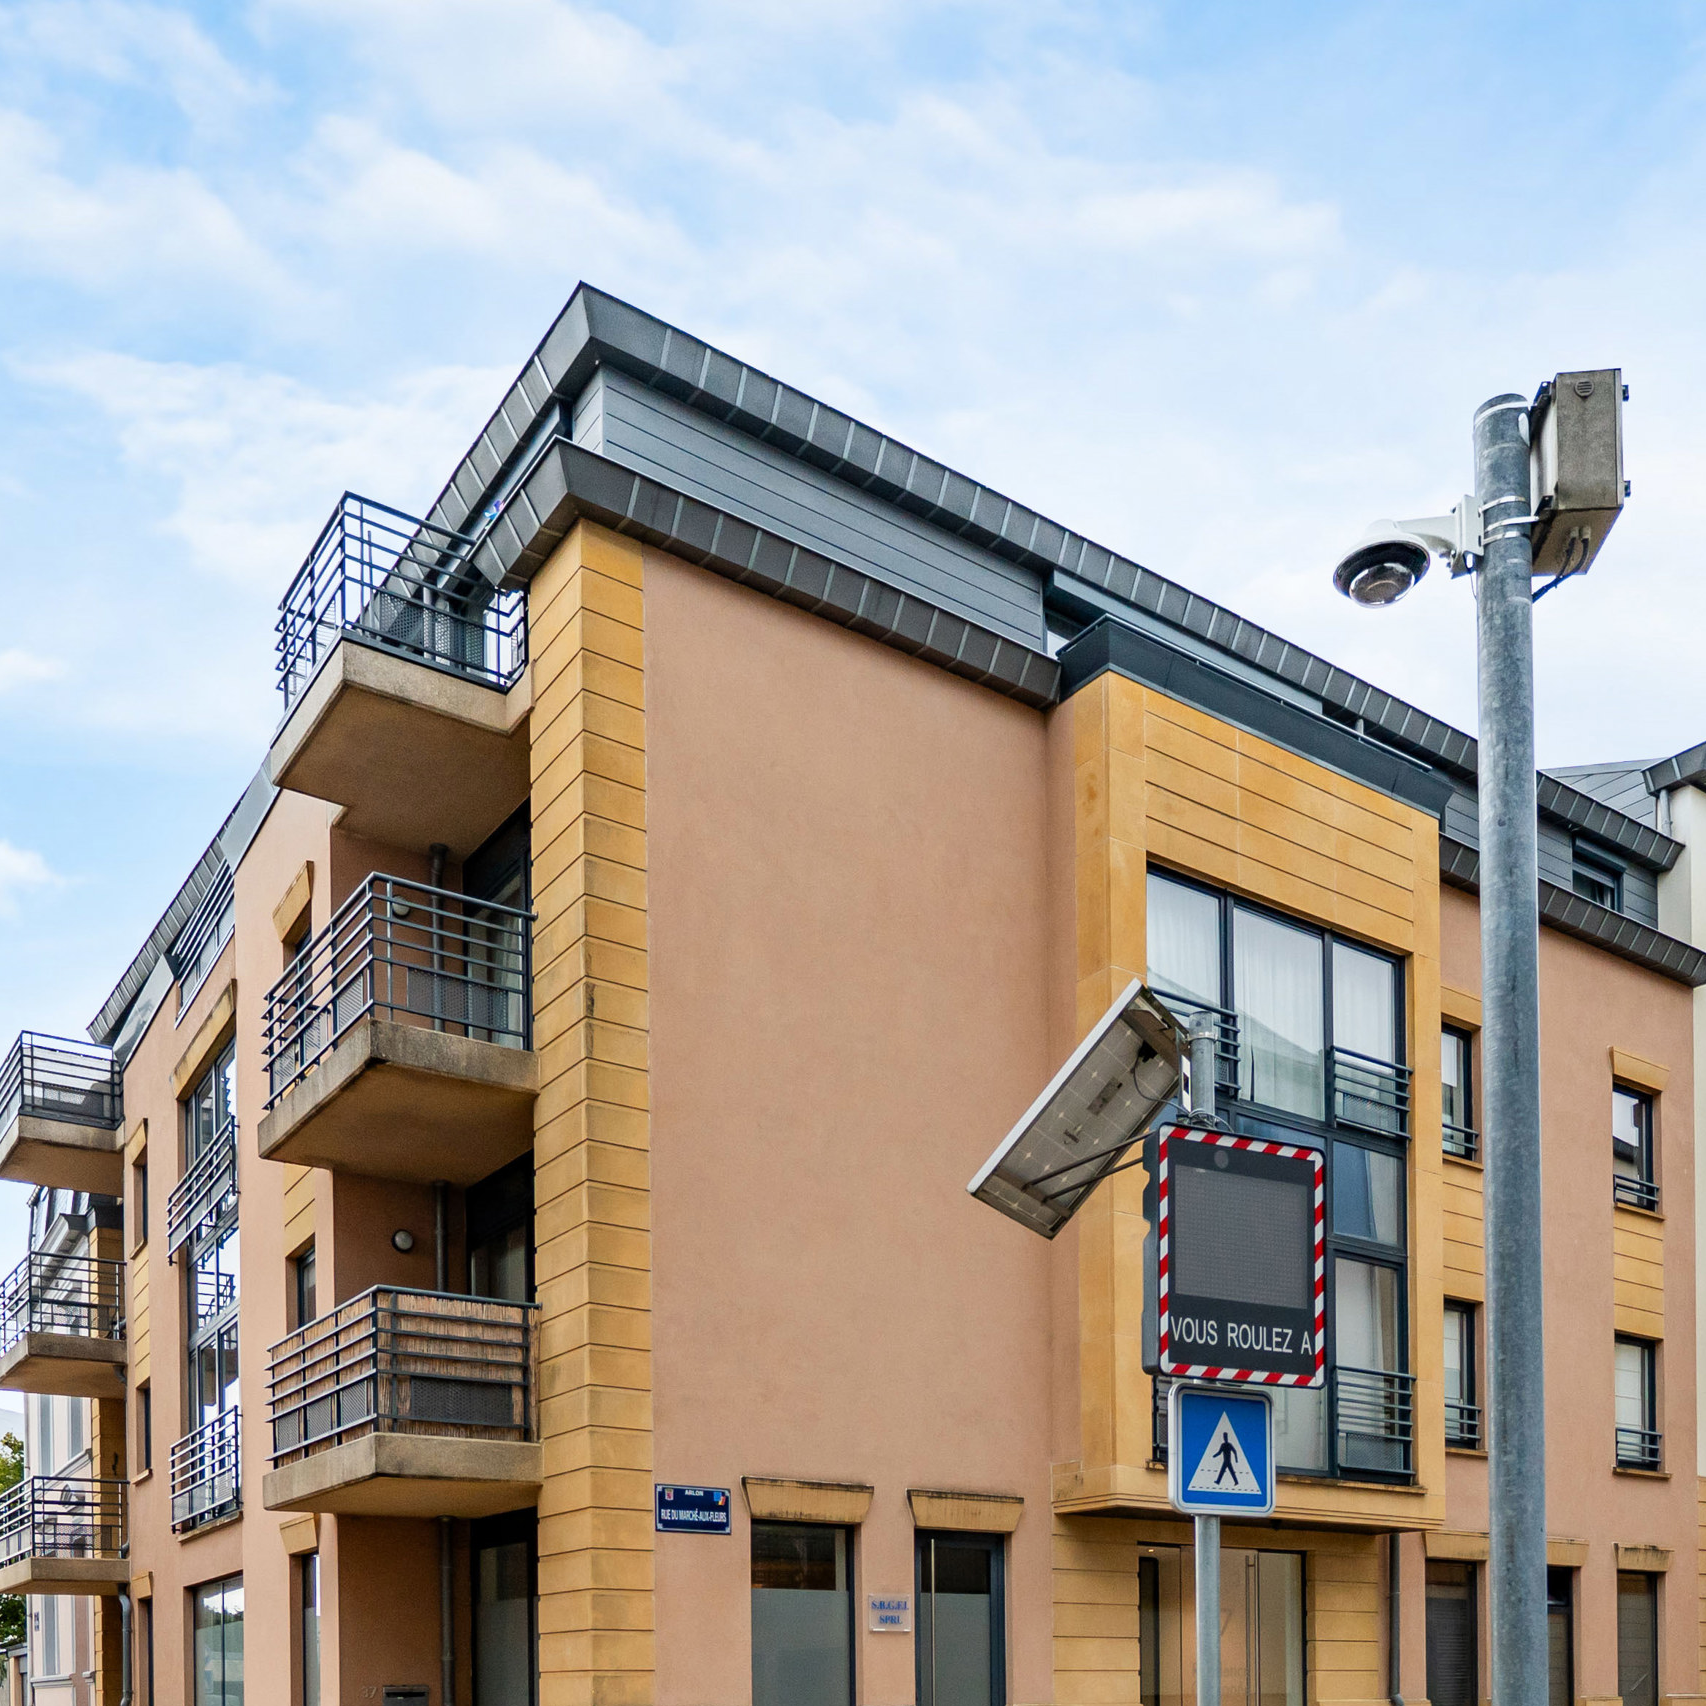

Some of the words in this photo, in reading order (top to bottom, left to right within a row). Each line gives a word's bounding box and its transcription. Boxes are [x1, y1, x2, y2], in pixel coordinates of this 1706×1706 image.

[1170, 1315, 1218, 1346] VOUS
[1227, 1322, 1293, 1353] ROULEZ
[1300, 1330, 1313, 1356] A
[684, 1489, 704, 1497] ARLON
[660, 1508, 671, 1520] RUE
[671, 1508, 679, 1521] DU
[879, 1615, 904, 1625] SPRL
